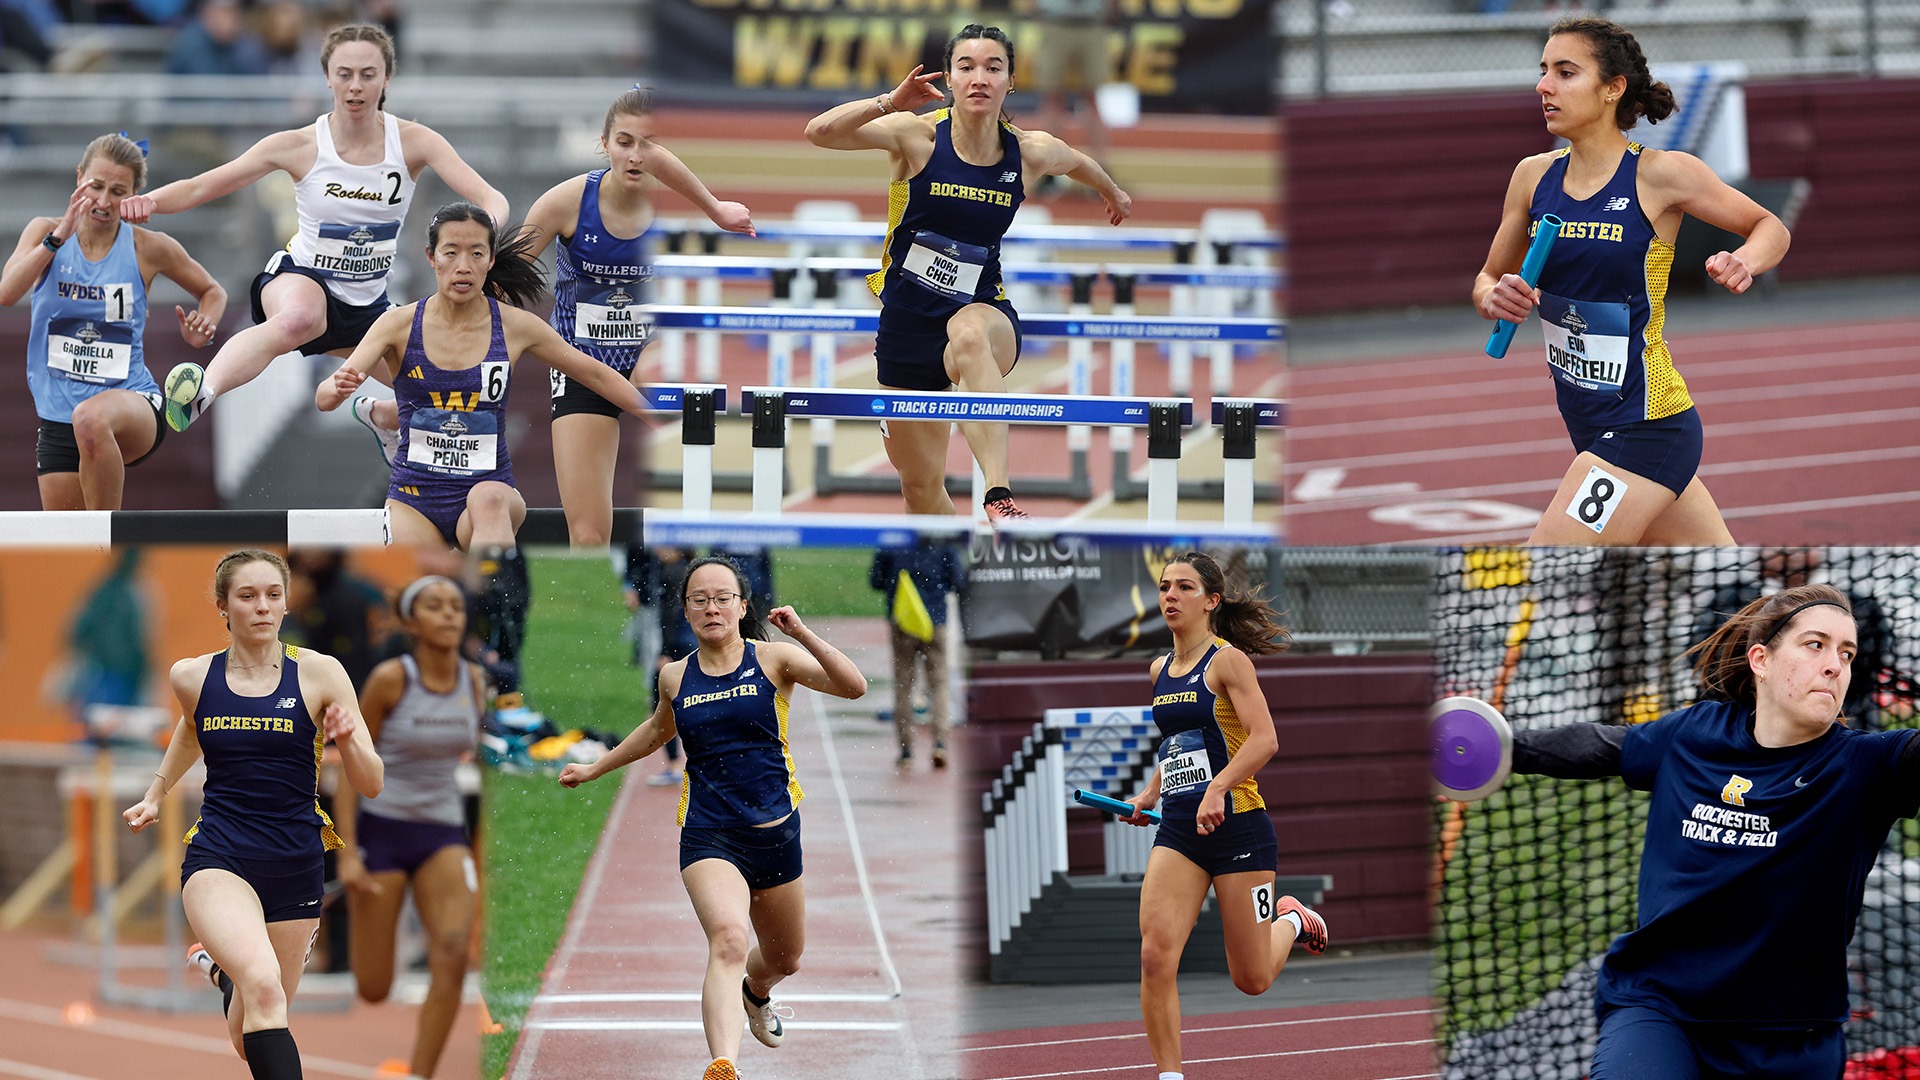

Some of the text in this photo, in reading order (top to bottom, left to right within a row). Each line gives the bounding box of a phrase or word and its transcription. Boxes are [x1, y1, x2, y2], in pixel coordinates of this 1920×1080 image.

[324, 183, 383, 201] Roches
[387, 171, 402, 205] 2
[930, 182, 1013, 207] ROCHESTER
[342, 246, 374, 257] MOLLY
[313, 254, 392, 273] FITZGIBBONS
[582, 261, 655, 276] WELLESLE
[932, 256, 959, 274] NORA
[925, 265, 958, 287] CHEN
[58, 282, 106, 300] WIDEN
[113, 287, 125, 320] 1
[607, 311, 632, 321] ELLA
[588, 323, 651, 339] WHINNEY
[63, 342, 114, 359] GABRIELLA
[1567, 335, 1585, 355] EVA
[72, 358, 99, 375] NYE
[1549, 343, 1621, 384] CIUFFETELLI
[487, 366, 503, 401] 6
[658, 394, 678, 402] GILL
[789, 399, 809, 407] GILL
[891, 401, 927, 414] TRACK
[928, 401, 937, 414] &
[937, 401, 969, 415] FIELD
[970, 403, 1064, 418] CHAMPIONSHIPS
[1123, 408, 1144, 416] GILL
[1258, 409, 1279, 418] GILL
[426, 435, 479, 451] CHARLENE
[433, 450, 469, 468] PENG
[1578, 477, 1615, 524] 8
[682, 684, 759, 709] ROCHESTER
[202, 716, 294, 734] ROCHESTER
[1721, 774, 1754, 807] R
[1691, 803, 1771, 832] ROCHESTER
[1682, 819, 1779, 848] TRACK & FIELD
[1256, 887, 1271, 919] 8
